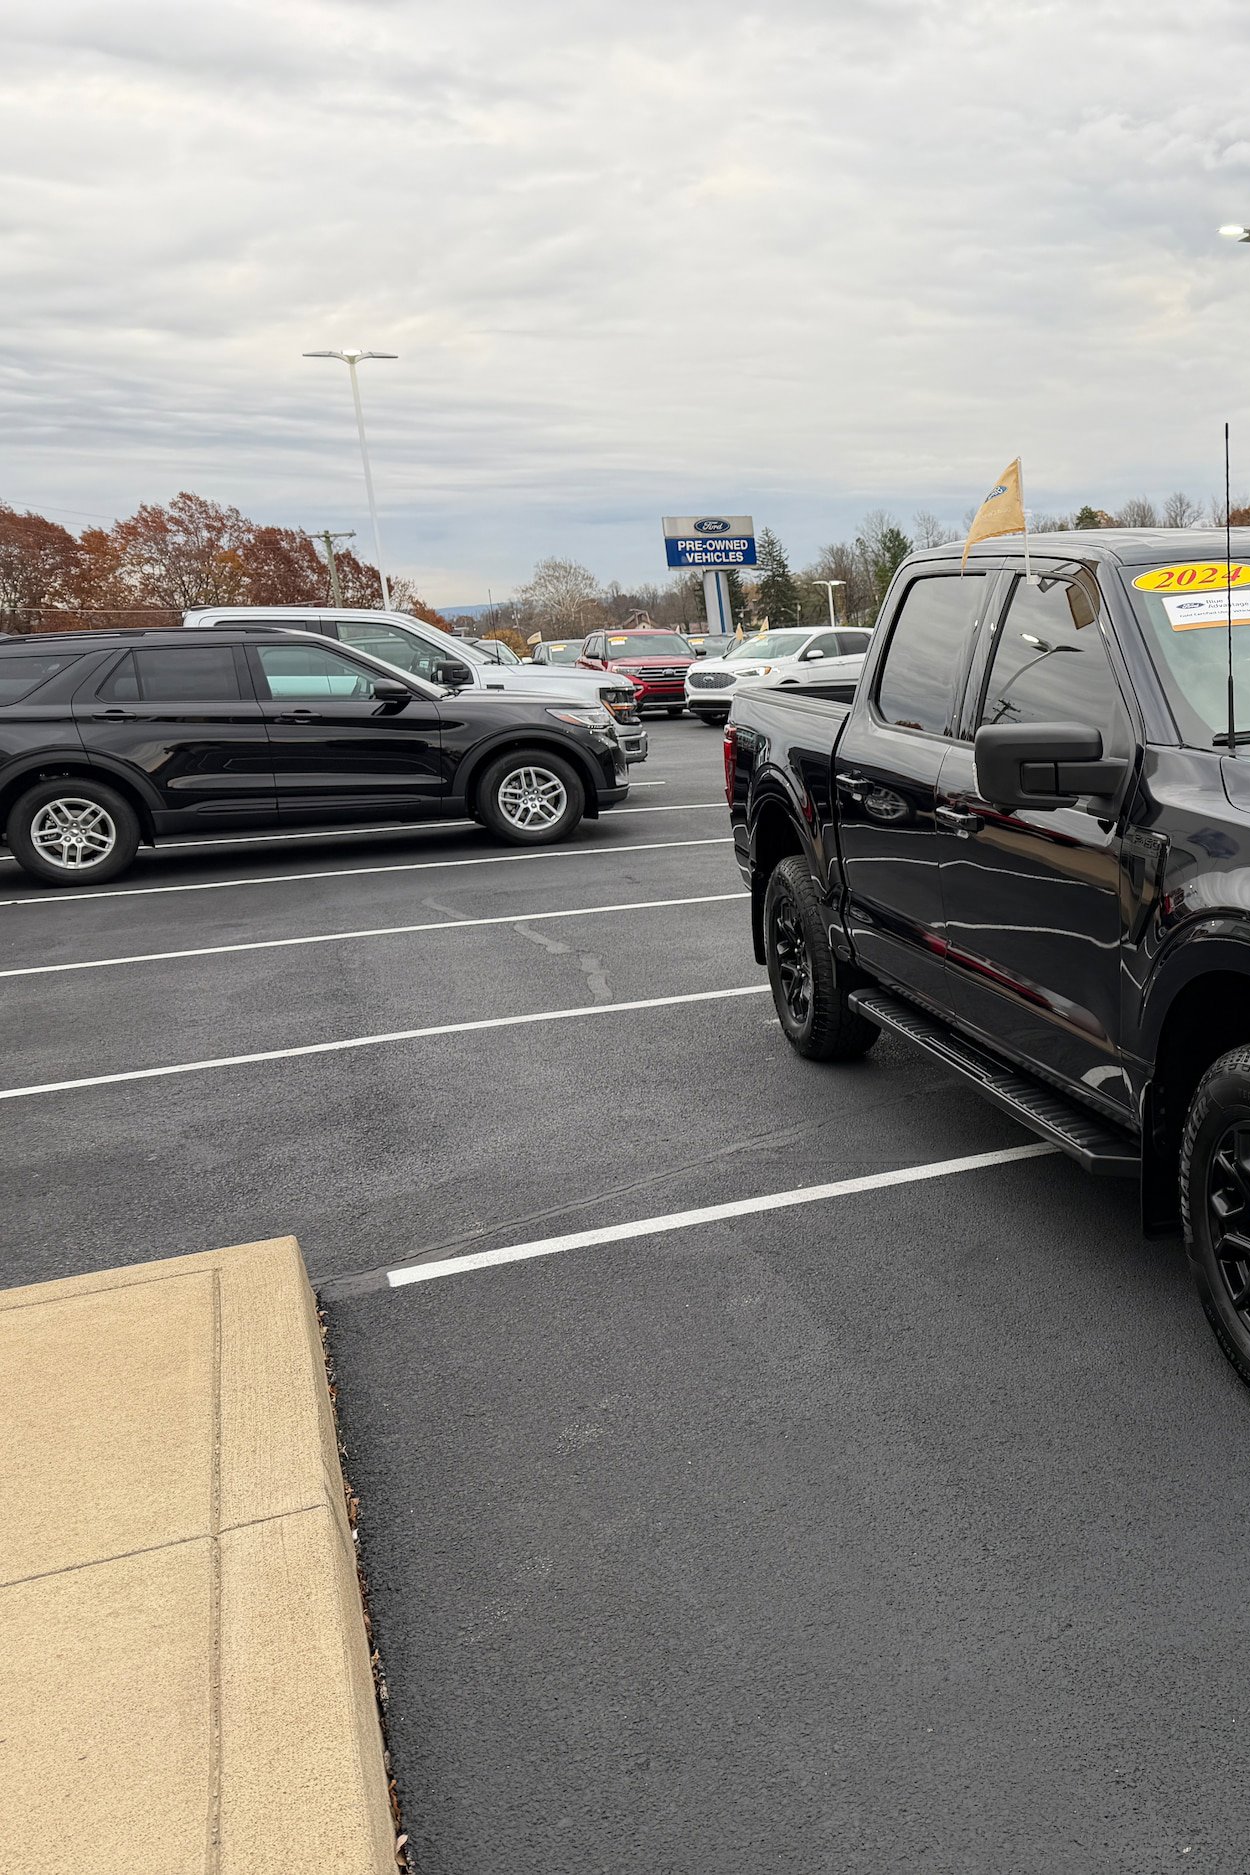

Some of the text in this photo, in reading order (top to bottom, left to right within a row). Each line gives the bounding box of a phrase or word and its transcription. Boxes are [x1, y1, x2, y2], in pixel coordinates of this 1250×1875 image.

[702, 521, 723, 531] Ford
[677, 540, 748, 551] PRE-OWNED
[685, 552, 744, 562] VEHICLES
[1153, 566, 1243, 589] 2024
[1179, 1096, 1211, 1244] WRANGLER
